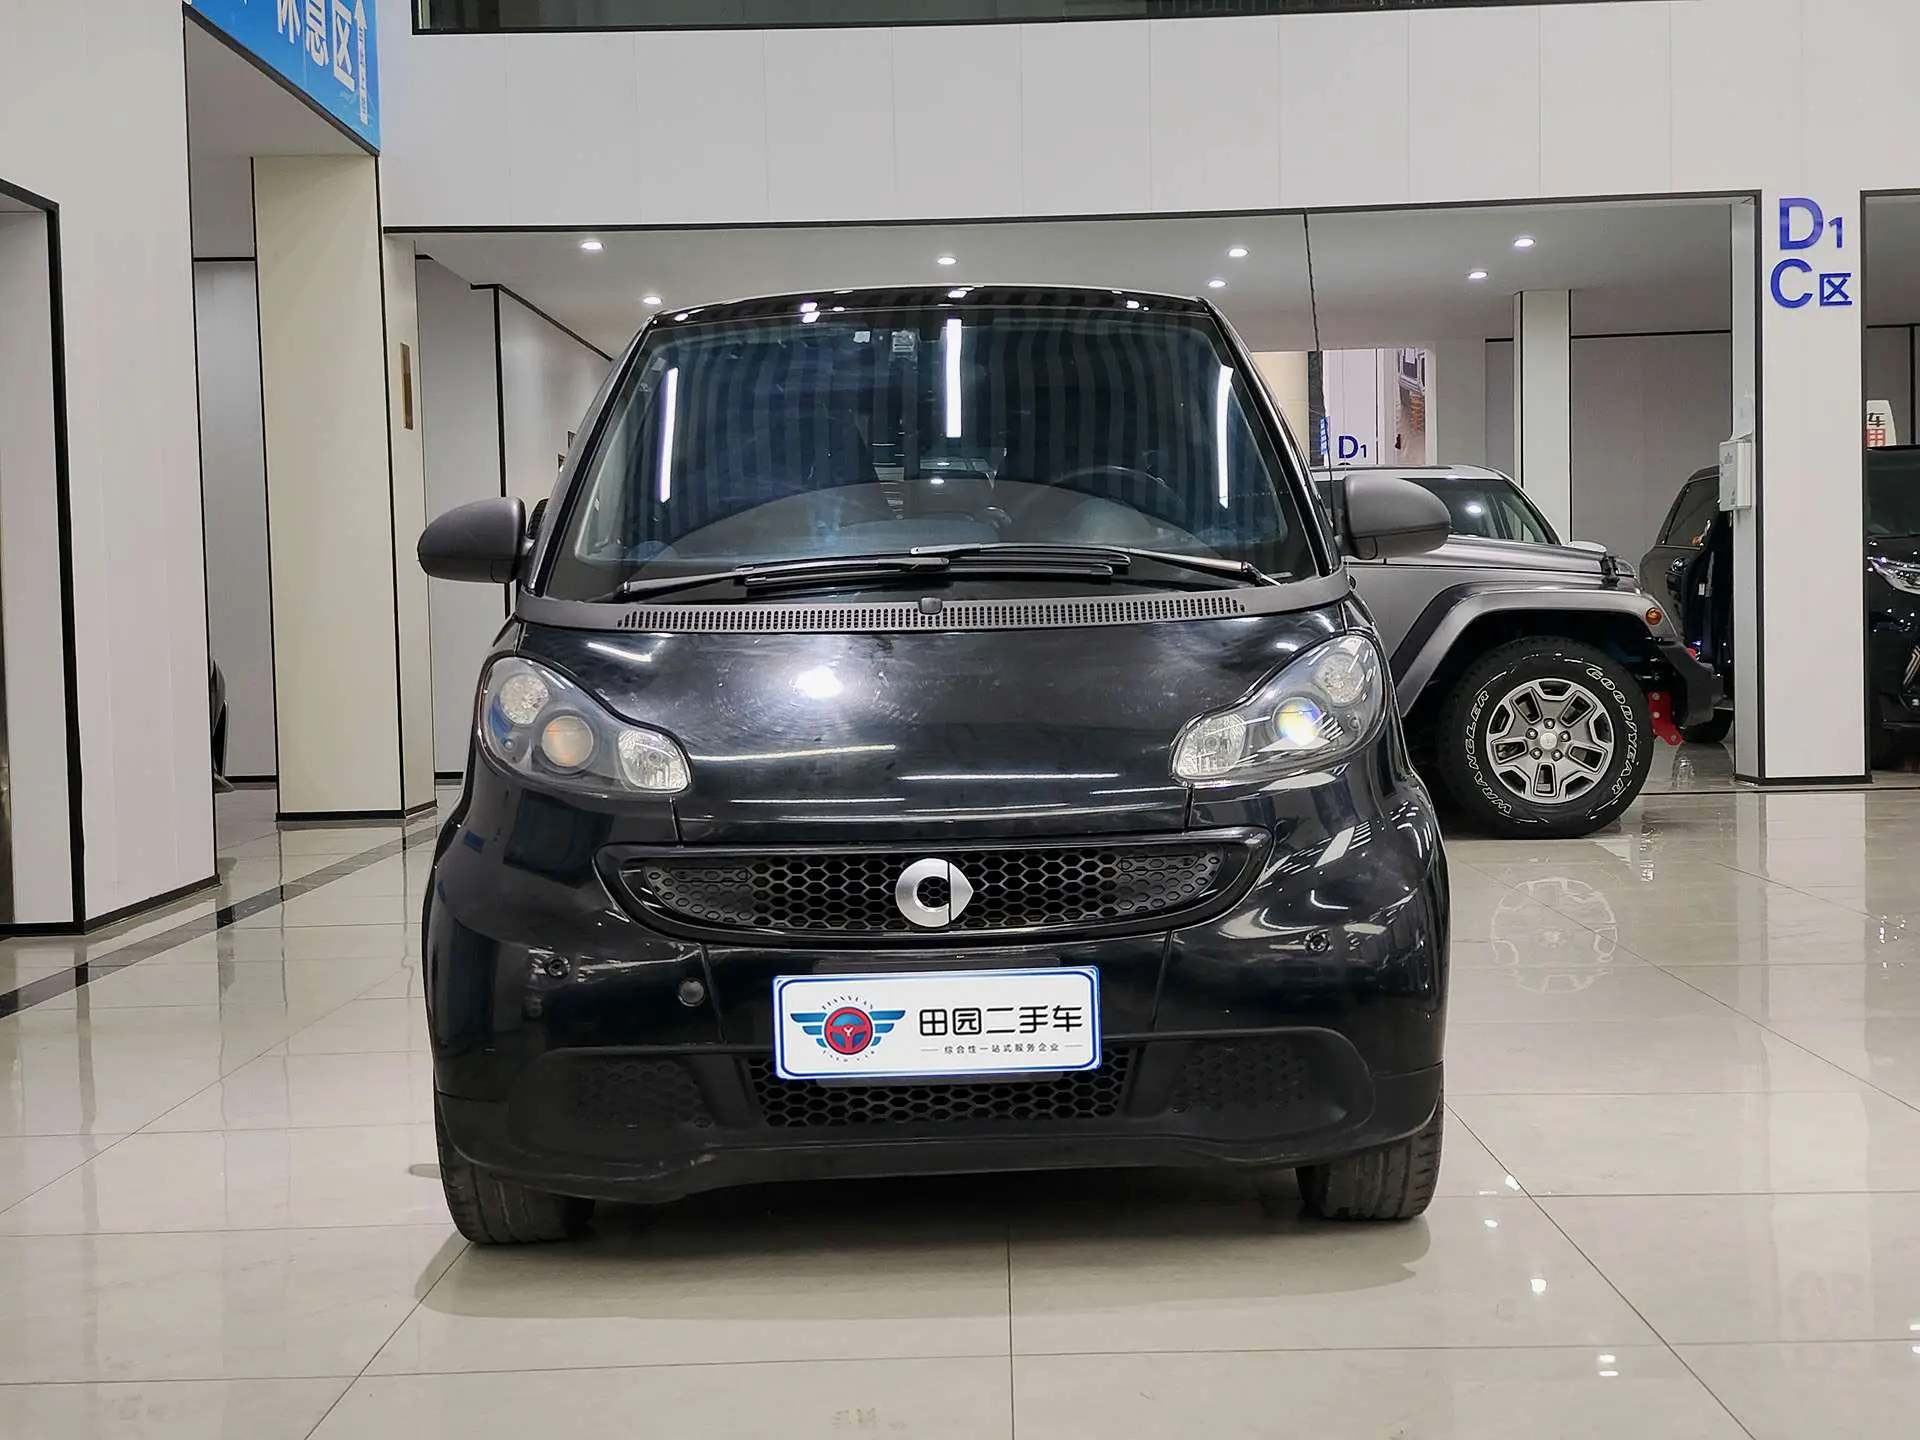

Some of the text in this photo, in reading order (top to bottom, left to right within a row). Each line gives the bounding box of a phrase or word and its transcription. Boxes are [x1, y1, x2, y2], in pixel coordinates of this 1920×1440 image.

[1779, 197, 1843, 250] D1
[1770, 258, 1852, 308] C区
[1868, 412, 1886, 427] 车
[1338, 435, 1367, 459] D1
[1586, 667, 1637, 795] GOODYEAR
[1465, 690, 1513, 814] WRANGLER
[919, 1005, 1082, 1036] 田园二手车
[944, 1043, 1059, 1054] 综合性一站式服务企业
